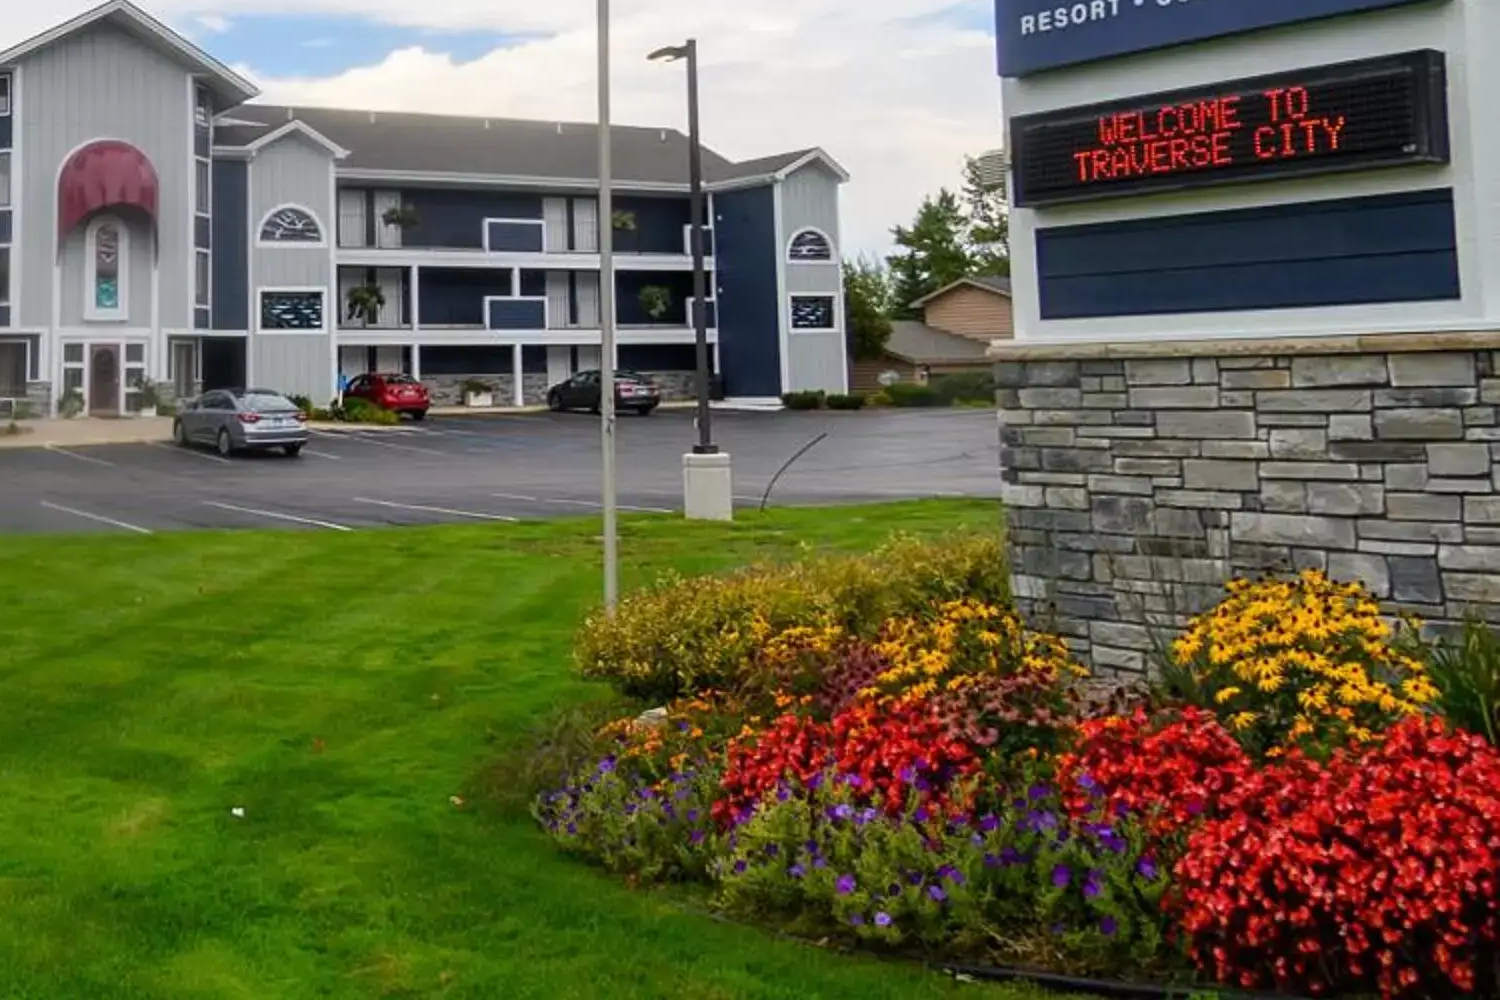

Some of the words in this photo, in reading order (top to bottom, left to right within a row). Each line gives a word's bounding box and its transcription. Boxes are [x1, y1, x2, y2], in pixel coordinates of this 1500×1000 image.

[1098, 94, 1242, 145] WELCOME
[1265, 87, 1310, 121] TO
[1074, 131, 1233, 182] TRAVERSE
[1254, 115, 1346, 159] CITY
